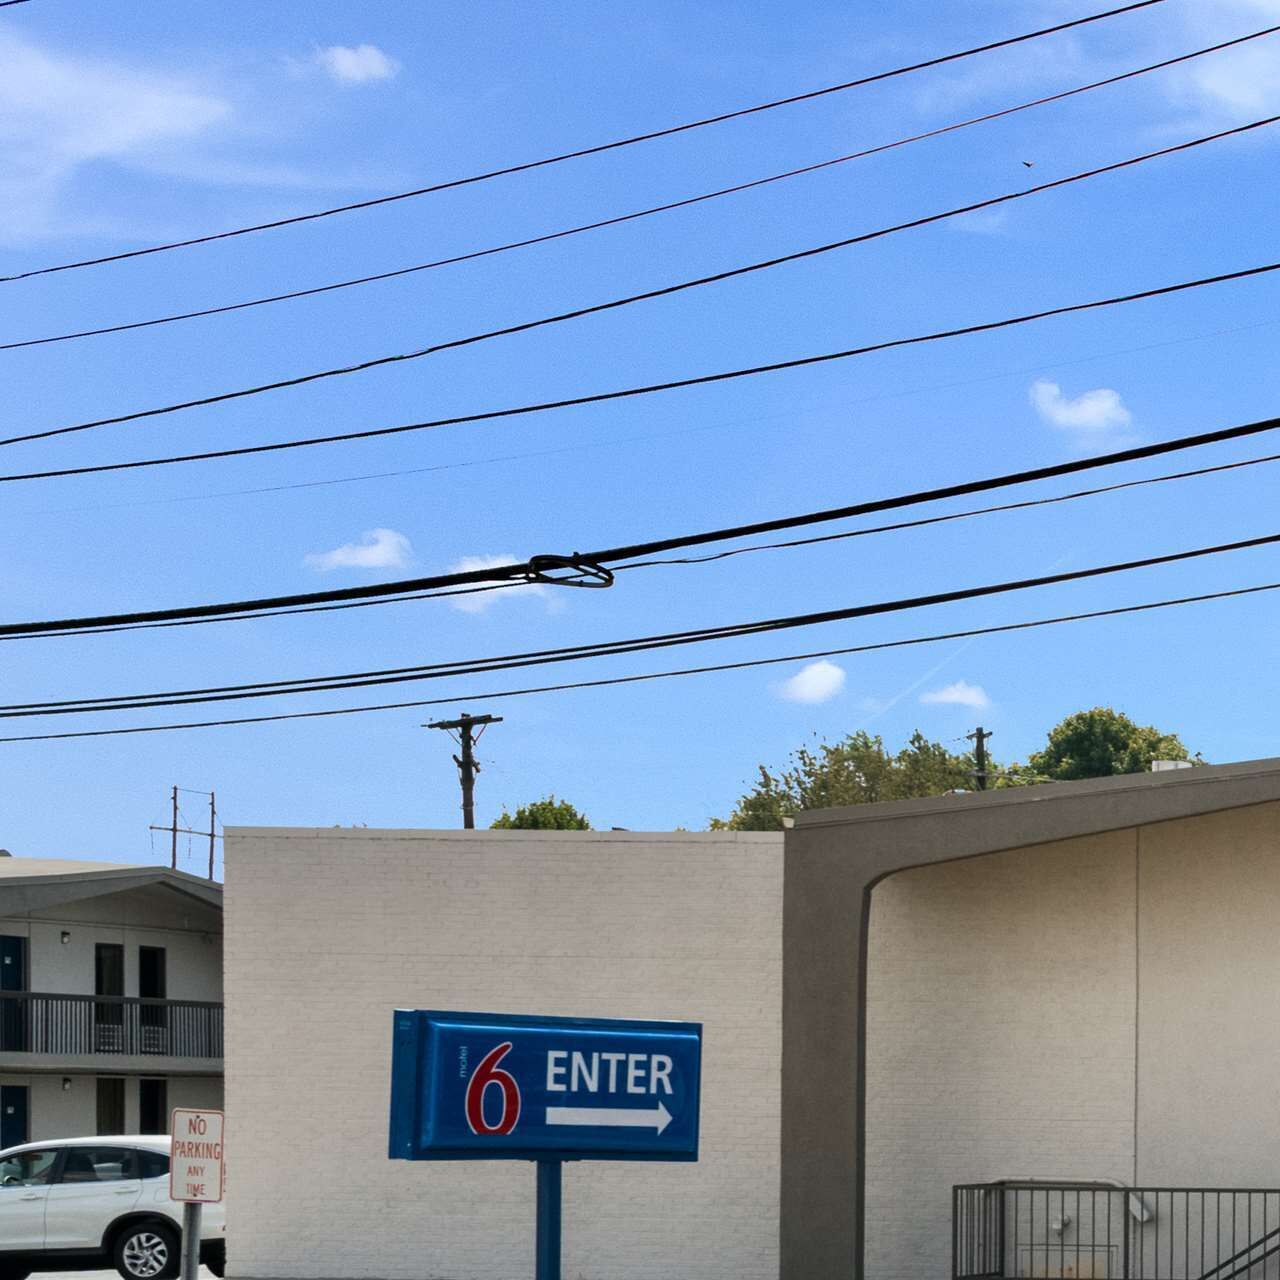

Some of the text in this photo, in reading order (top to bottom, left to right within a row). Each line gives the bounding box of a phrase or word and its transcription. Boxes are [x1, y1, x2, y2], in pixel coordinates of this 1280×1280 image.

[459, 1045, 468, 1078] motel
[546, 1050, 674, 1095] ENTER
[465, 1041, 521, 1135] 6
[188, 1118, 207, 1135] NO
[174, 1141, 221, 1160] PARKING
[187, 1166, 206, 1176] ANY
[186, 1183, 206, 1195] TIME
